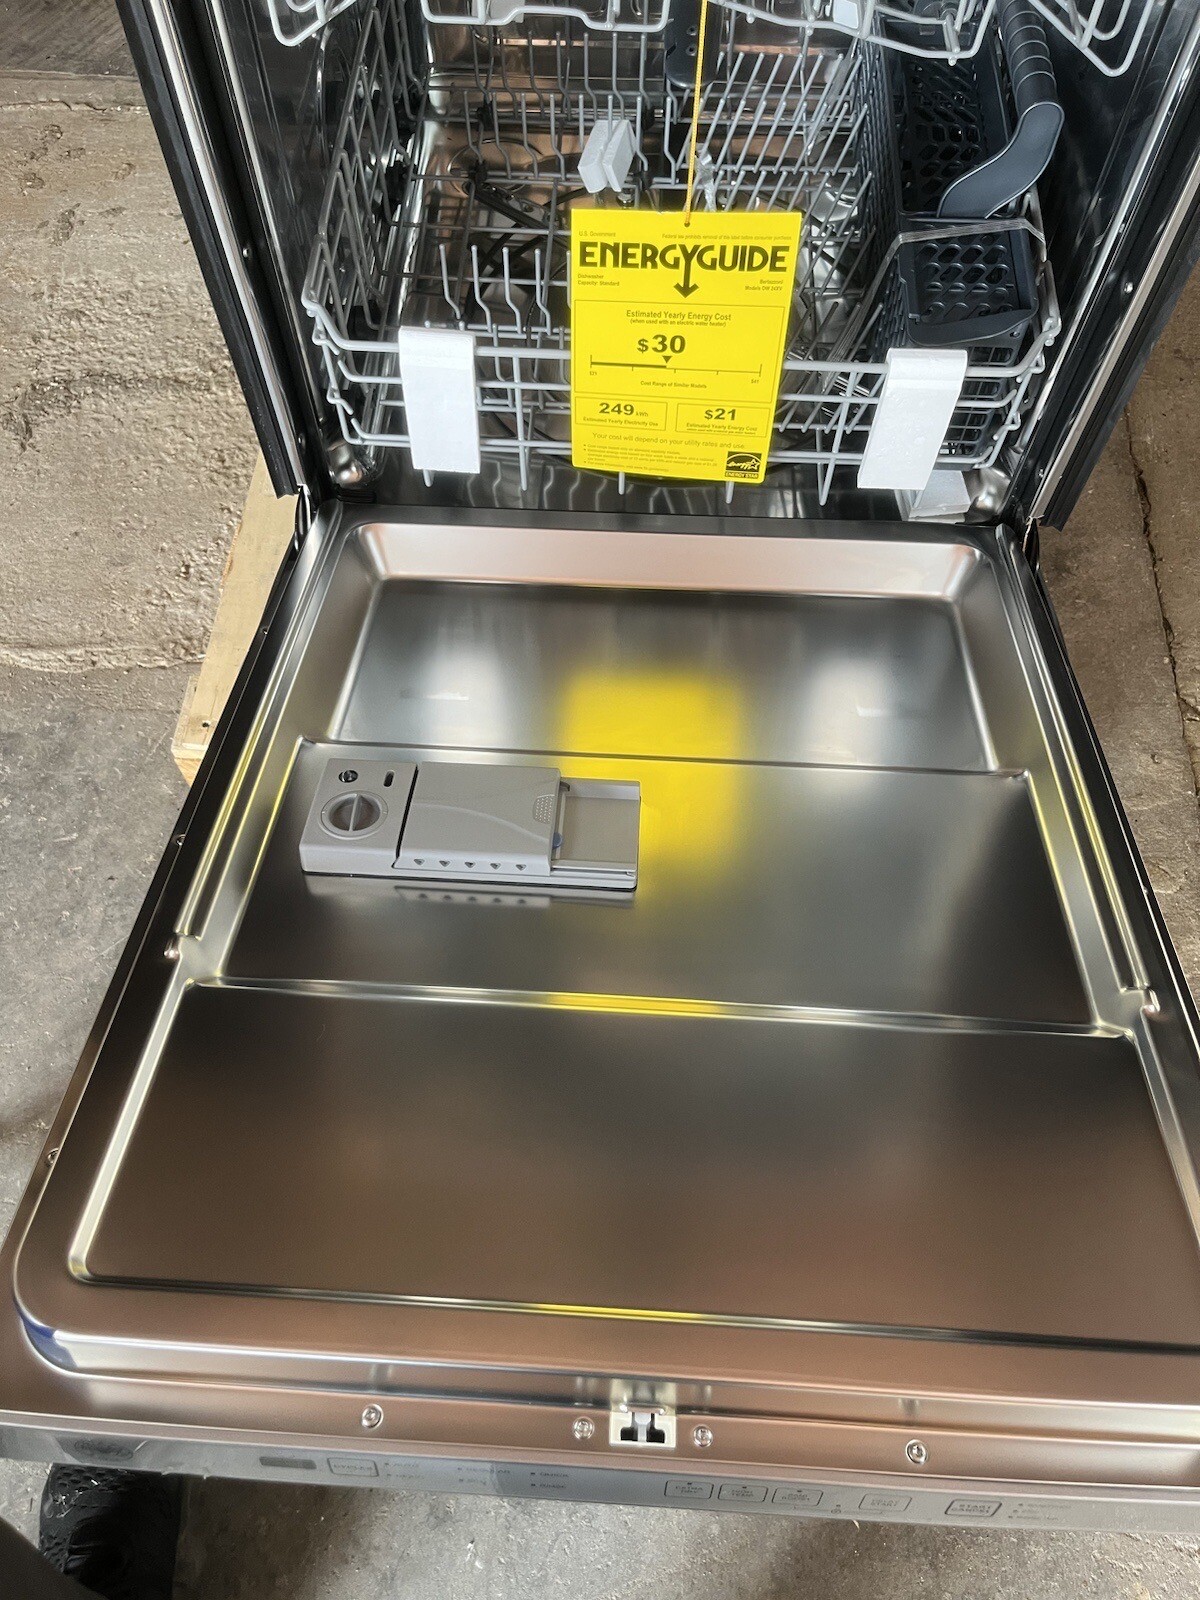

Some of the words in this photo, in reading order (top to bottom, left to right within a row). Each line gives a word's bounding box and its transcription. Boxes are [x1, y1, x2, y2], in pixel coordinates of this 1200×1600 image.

[578, 241, 790, 273] ENERGYGUIDE
[626, 310, 662, 319] Estimated
[663, 311, 686, 320] Yearly
[687, 312, 713, 321] Energy
[714, 313, 732, 321] Cost
[637, 334, 686, 354] $30
[598, 402, 635, 416] 249
[704, 408, 736, 421] $21
[624, 419, 648, 427] Electricity
[592, 432, 607, 440] Your
[623, 434, 634, 442] will
[634, 436, 658, 444] depend
[669, 438, 683, 446] your
[684, 439, 700, 447] utility
